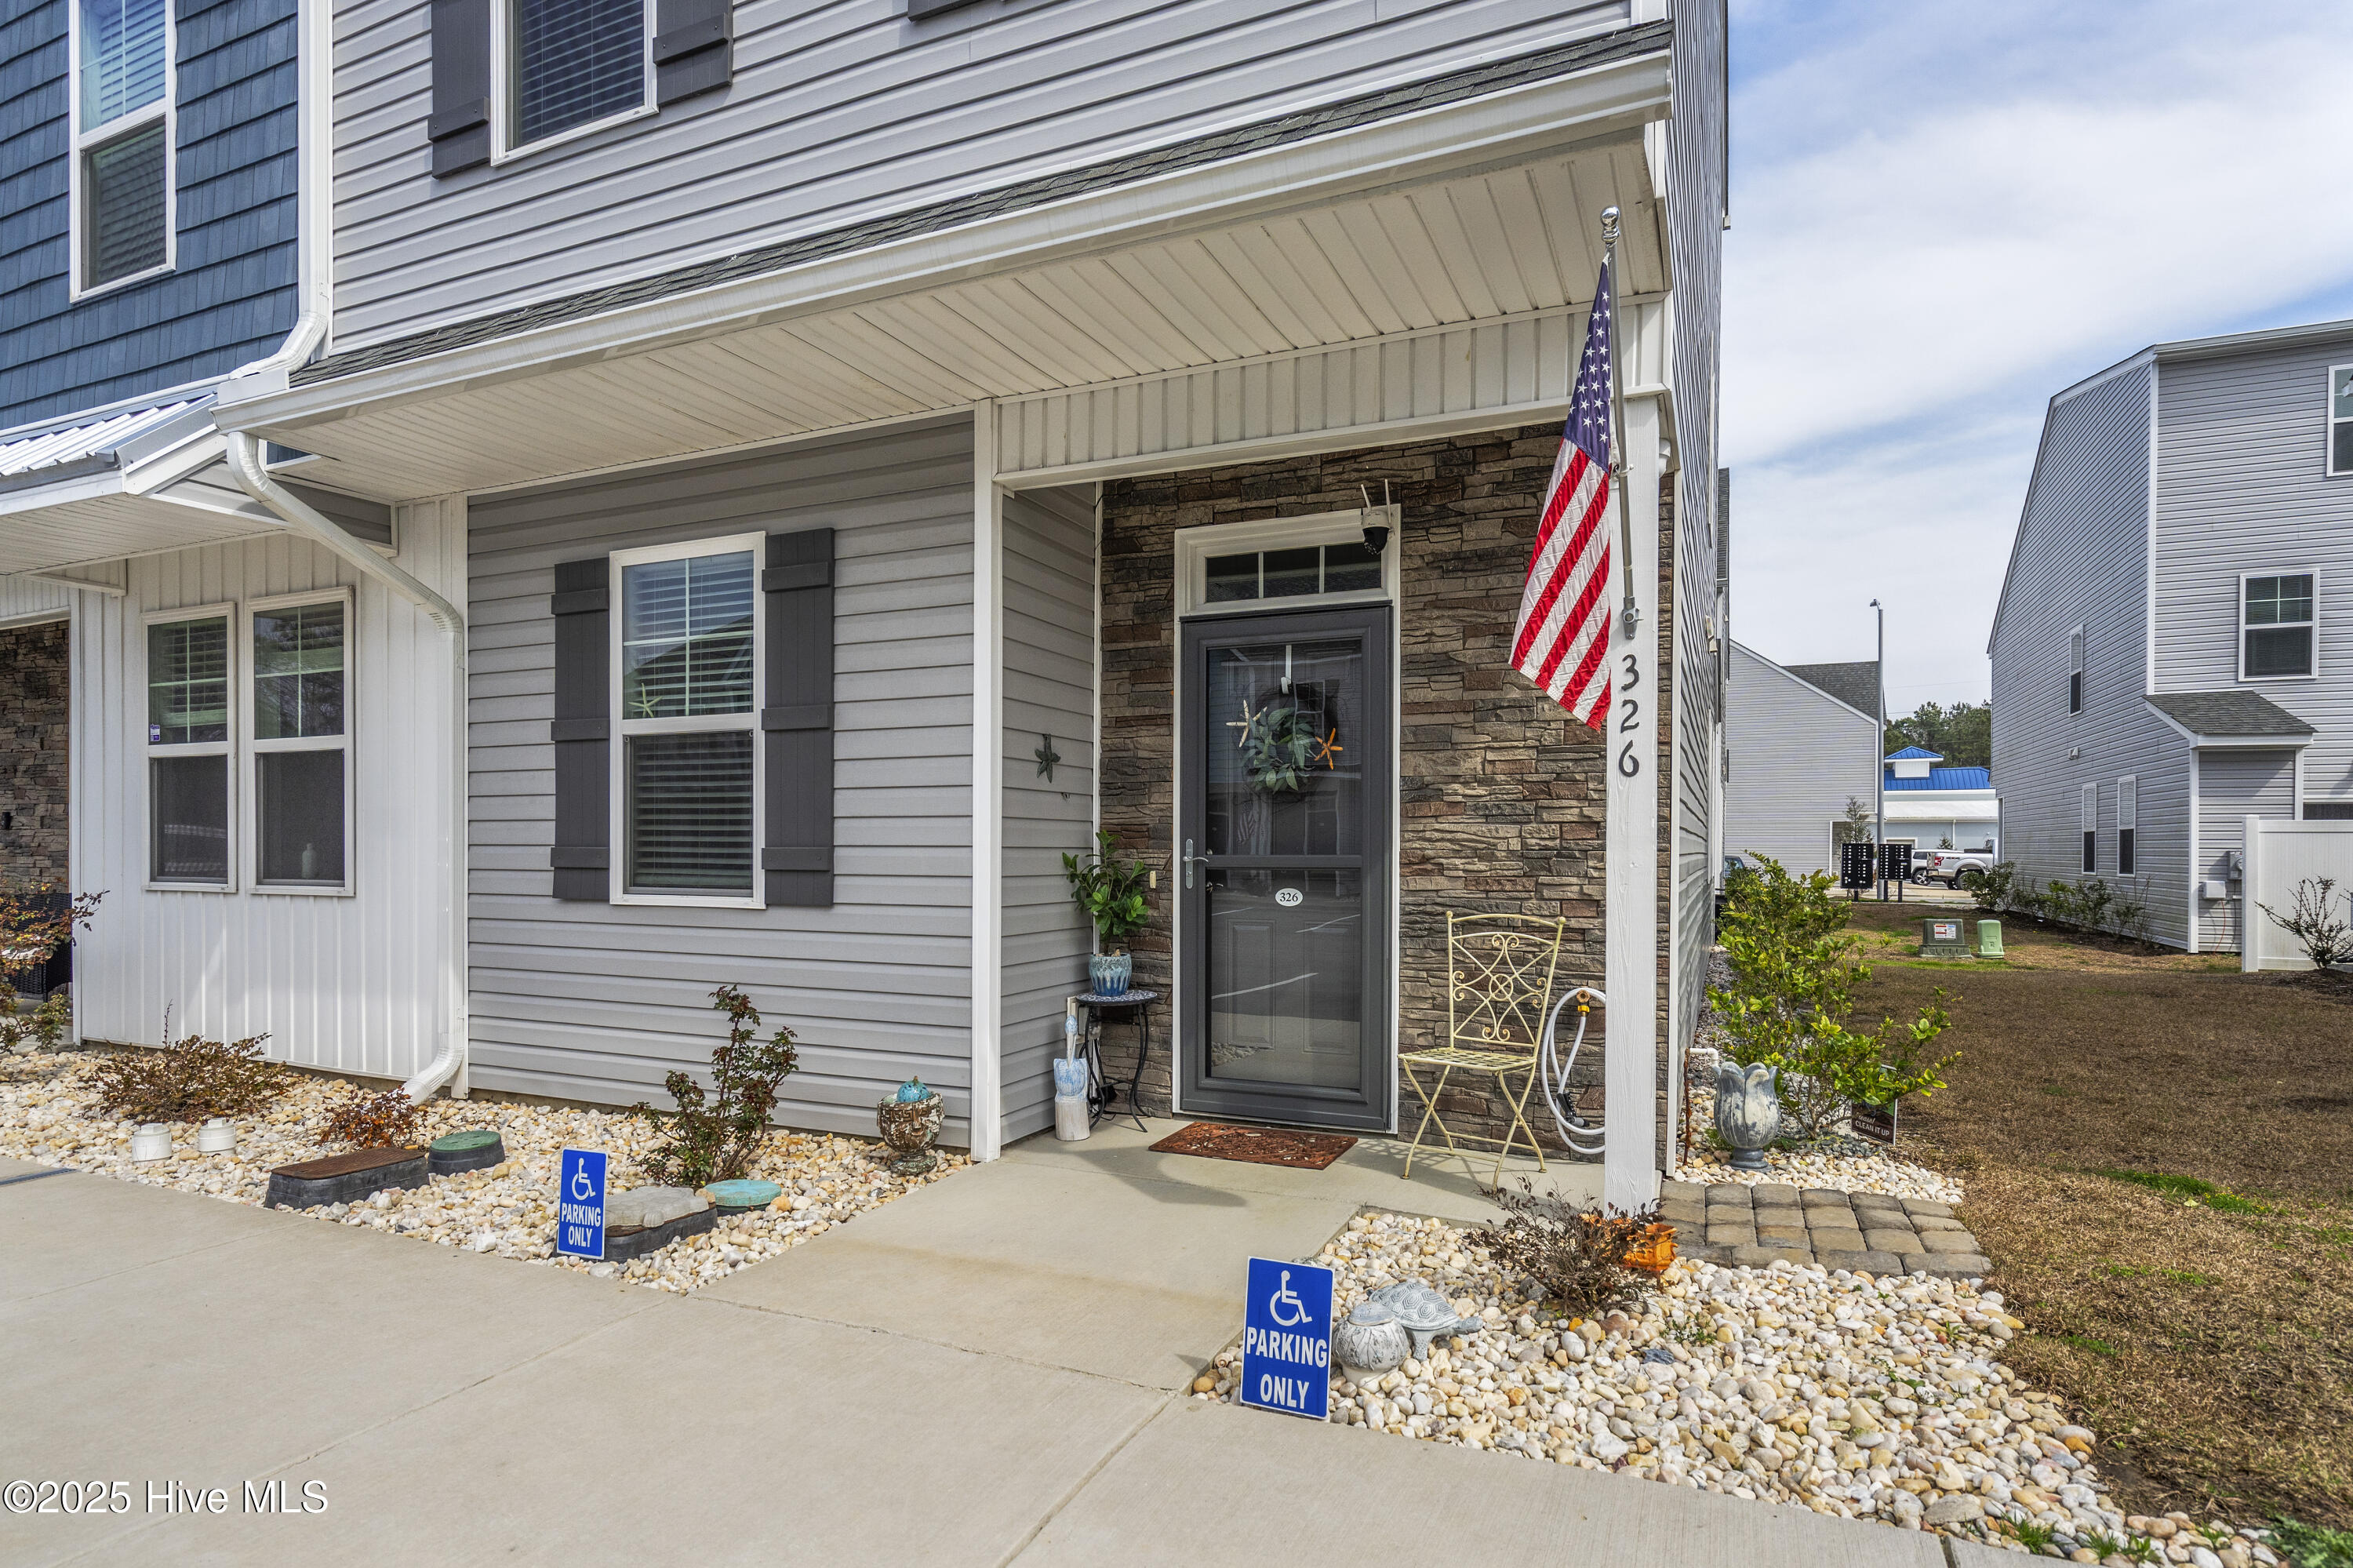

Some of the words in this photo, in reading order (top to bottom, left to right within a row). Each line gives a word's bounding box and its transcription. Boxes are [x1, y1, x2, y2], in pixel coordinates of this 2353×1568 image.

[1618, 653, 1640, 778] 326
[1279, 892, 1299, 902] 326
[1855, 1120, 1874, 1132] CLEAN
[561, 1202, 602, 1228] PARKING
[568, 1225, 593, 1248] ONLY
[1246, 1326, 1328, 1368] PARKING
[1260, 1373, 1310, 1410] ONLY
